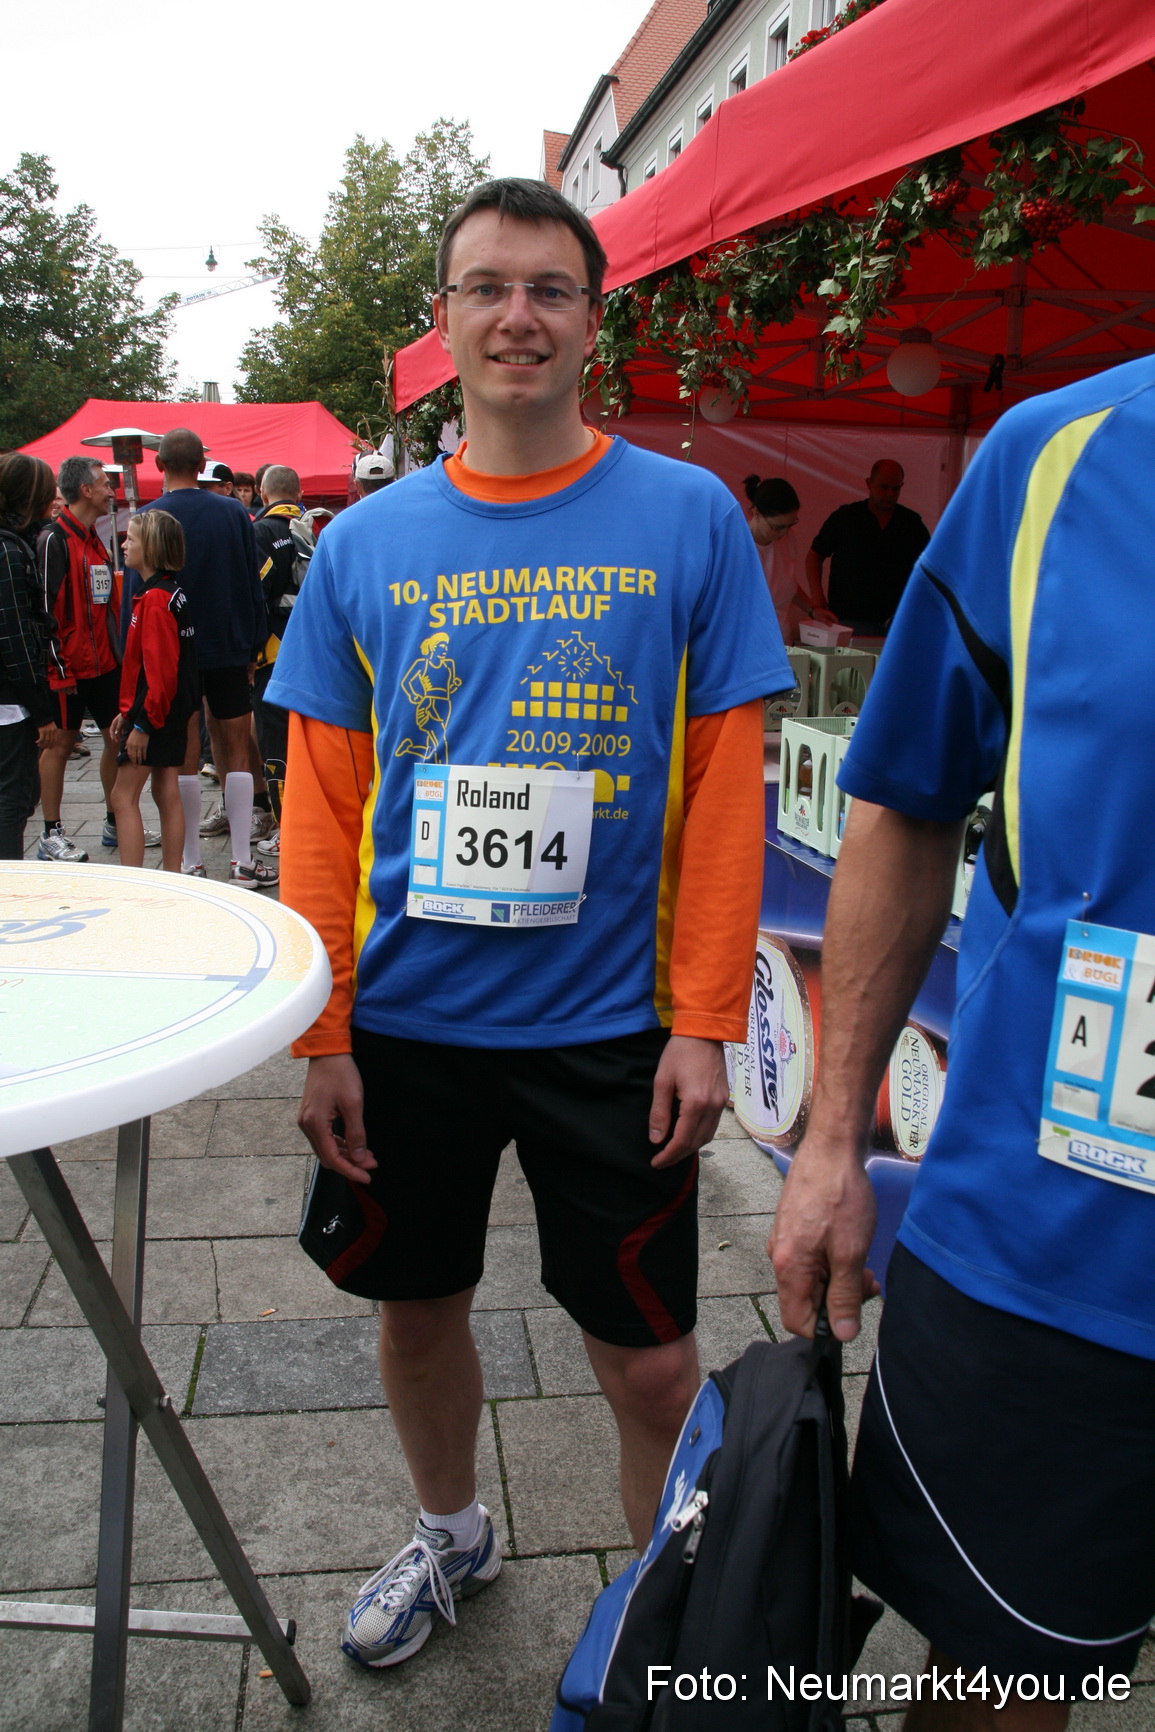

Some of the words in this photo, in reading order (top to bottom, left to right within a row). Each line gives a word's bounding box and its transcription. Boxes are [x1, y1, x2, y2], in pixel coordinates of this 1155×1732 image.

[388, 580, 429, 606] 10.
[437, 566, 657, 600] NEUMARKTER
[429, 595, 611, 628] STADTLAUF
[506, 730, 631, 757] 20.09.2009
[456, 780, 531, 811] Roland
[592, 807, 629, 820] rkt.de
[421, 821, 430, 841] D
[456, 826, 568, 871] 3614
[422, 900, 464, 914] BOCK
[513, 901, 577, 916] PFLEIDERER
[754, 950, 780, 1122] Glossner
[1071, 1015, 1087, 1047] A
[901, 1059, 912, 1122] GOLD
[908, 1036, 922, 1149] NEUMARKTER
[920, 1063, 929, 1129] ORIGINAL
[1068, 1140, 1147, 1174] BOCK
